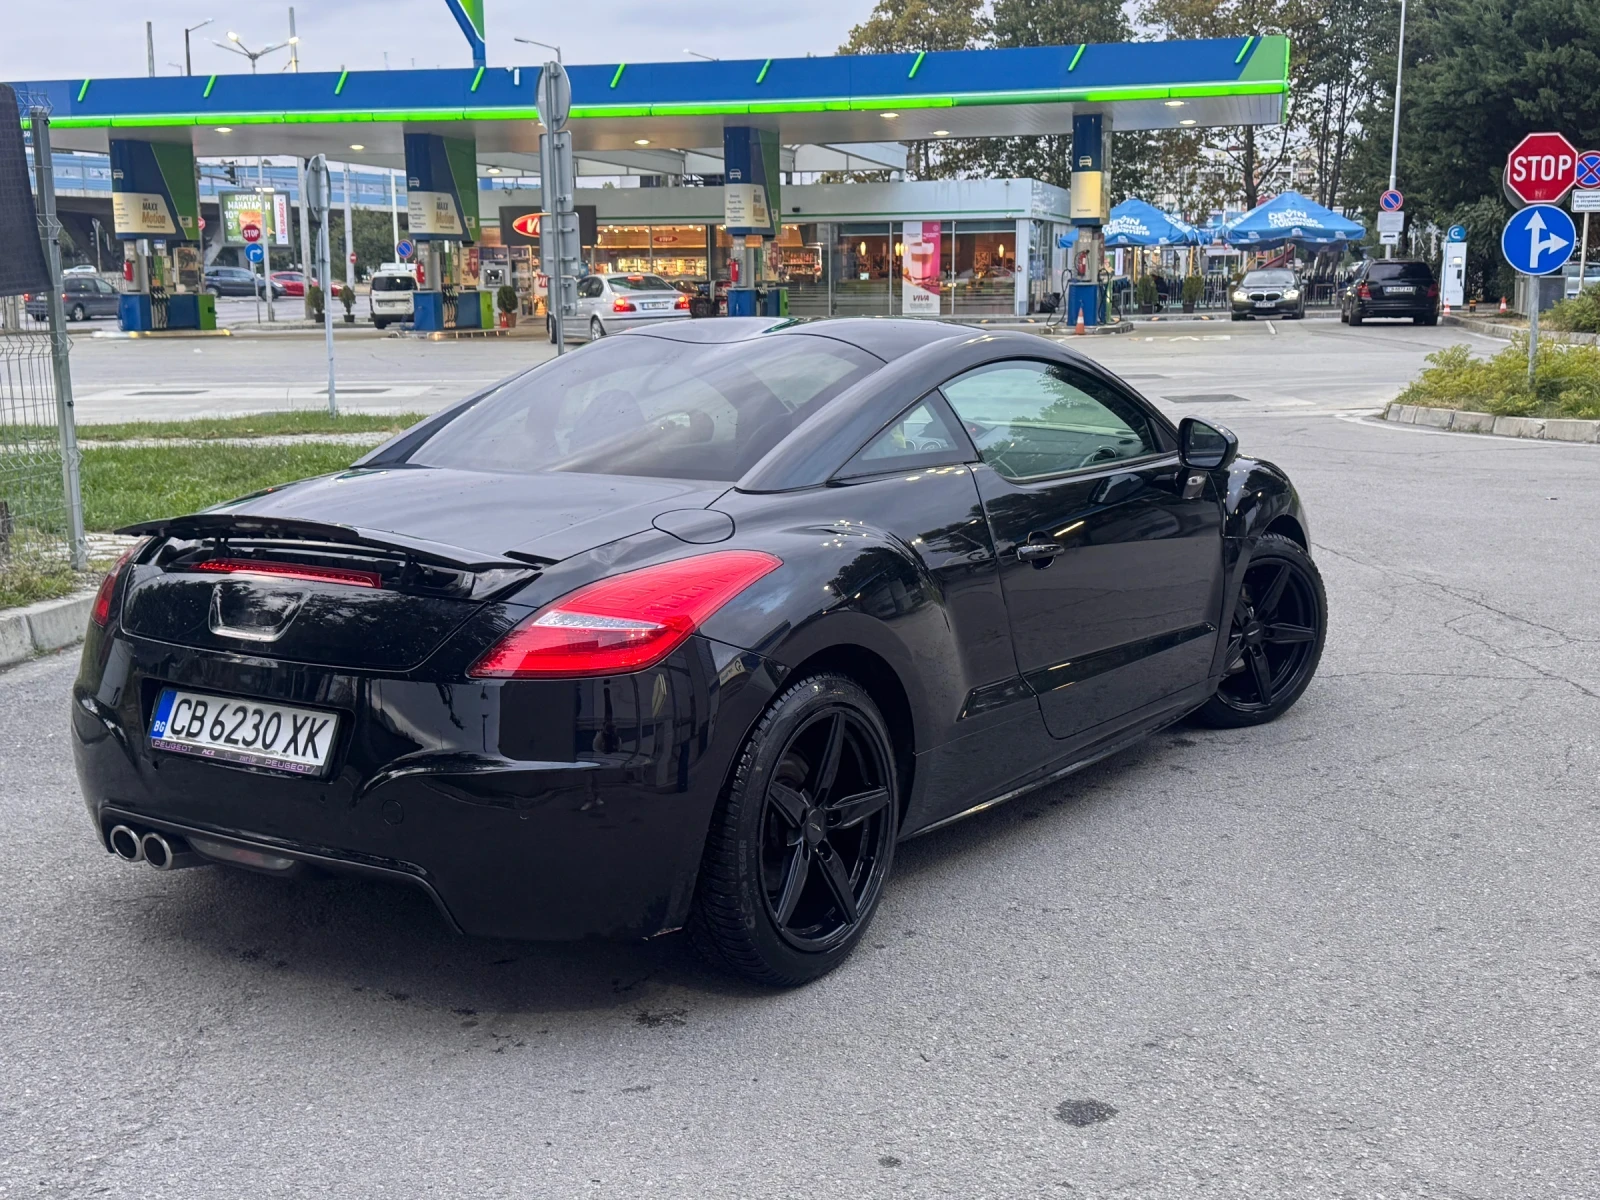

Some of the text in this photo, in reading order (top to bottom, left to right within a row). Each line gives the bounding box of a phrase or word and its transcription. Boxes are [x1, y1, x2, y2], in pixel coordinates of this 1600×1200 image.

[1512, 154, 1572, 182] STOP
[142, 202, 158, 211] MAXX
[141, 211, 166, 224] Motion
[1268, 208, 1308, 219] DEVIN
[243, 230, 260, 238] STOP
[912, 294, 930, 302] VIVA
[153, 720, 166, 733] BG
[170, 698, 330, 759] CB 6230 XK
[154, 740, 193, 753] PEUGEOT
[265, 758, 311, 773] PEUGEOT
